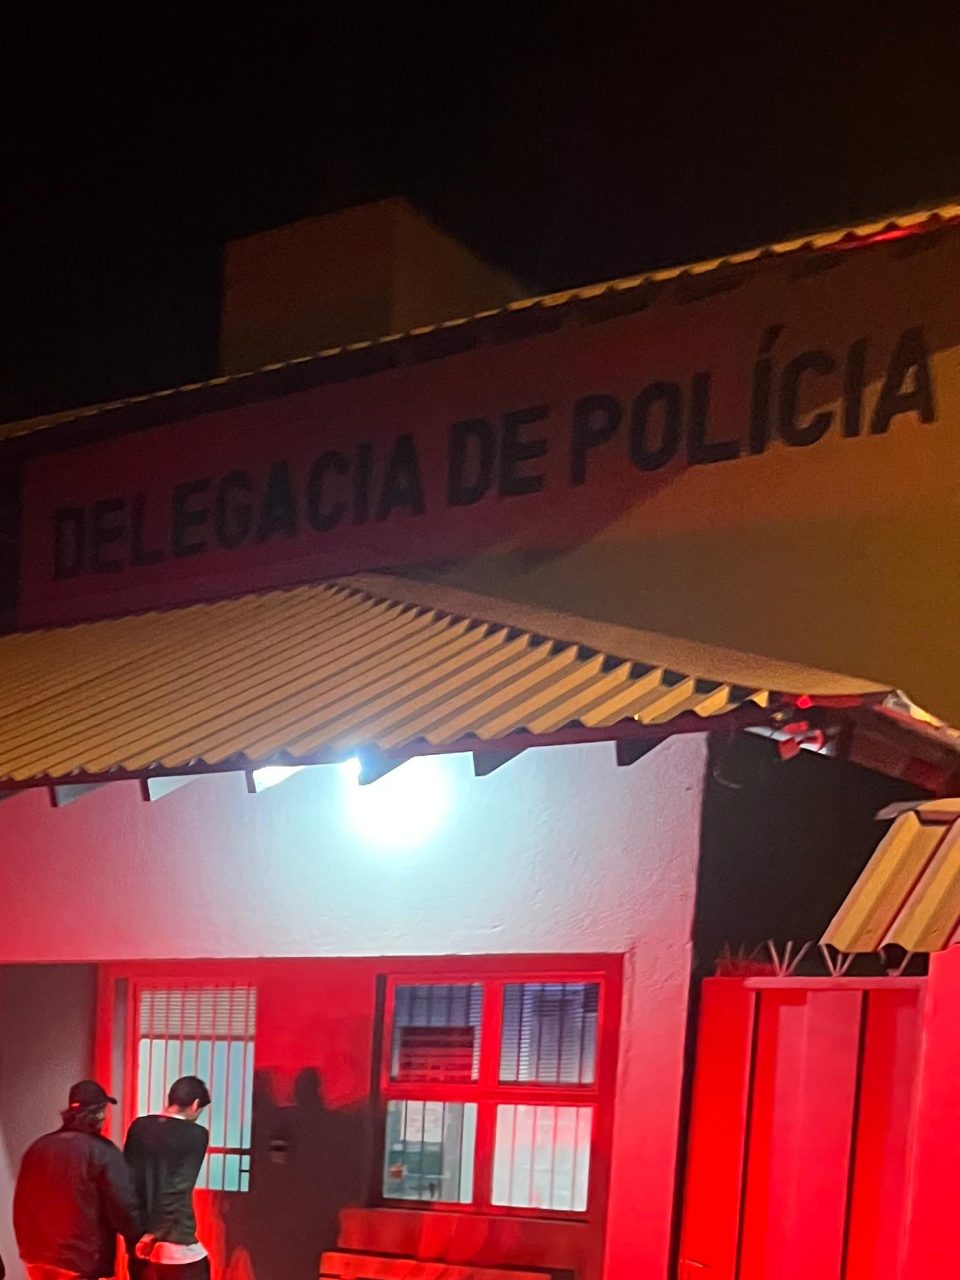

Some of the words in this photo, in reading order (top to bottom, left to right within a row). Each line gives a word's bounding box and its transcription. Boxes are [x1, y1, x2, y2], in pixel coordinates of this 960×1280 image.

[53, 433, 426, 580] DELEGACIA
[447, 405, 548, 508] DE
[571, 325, 936, 487] POLÍCIA
